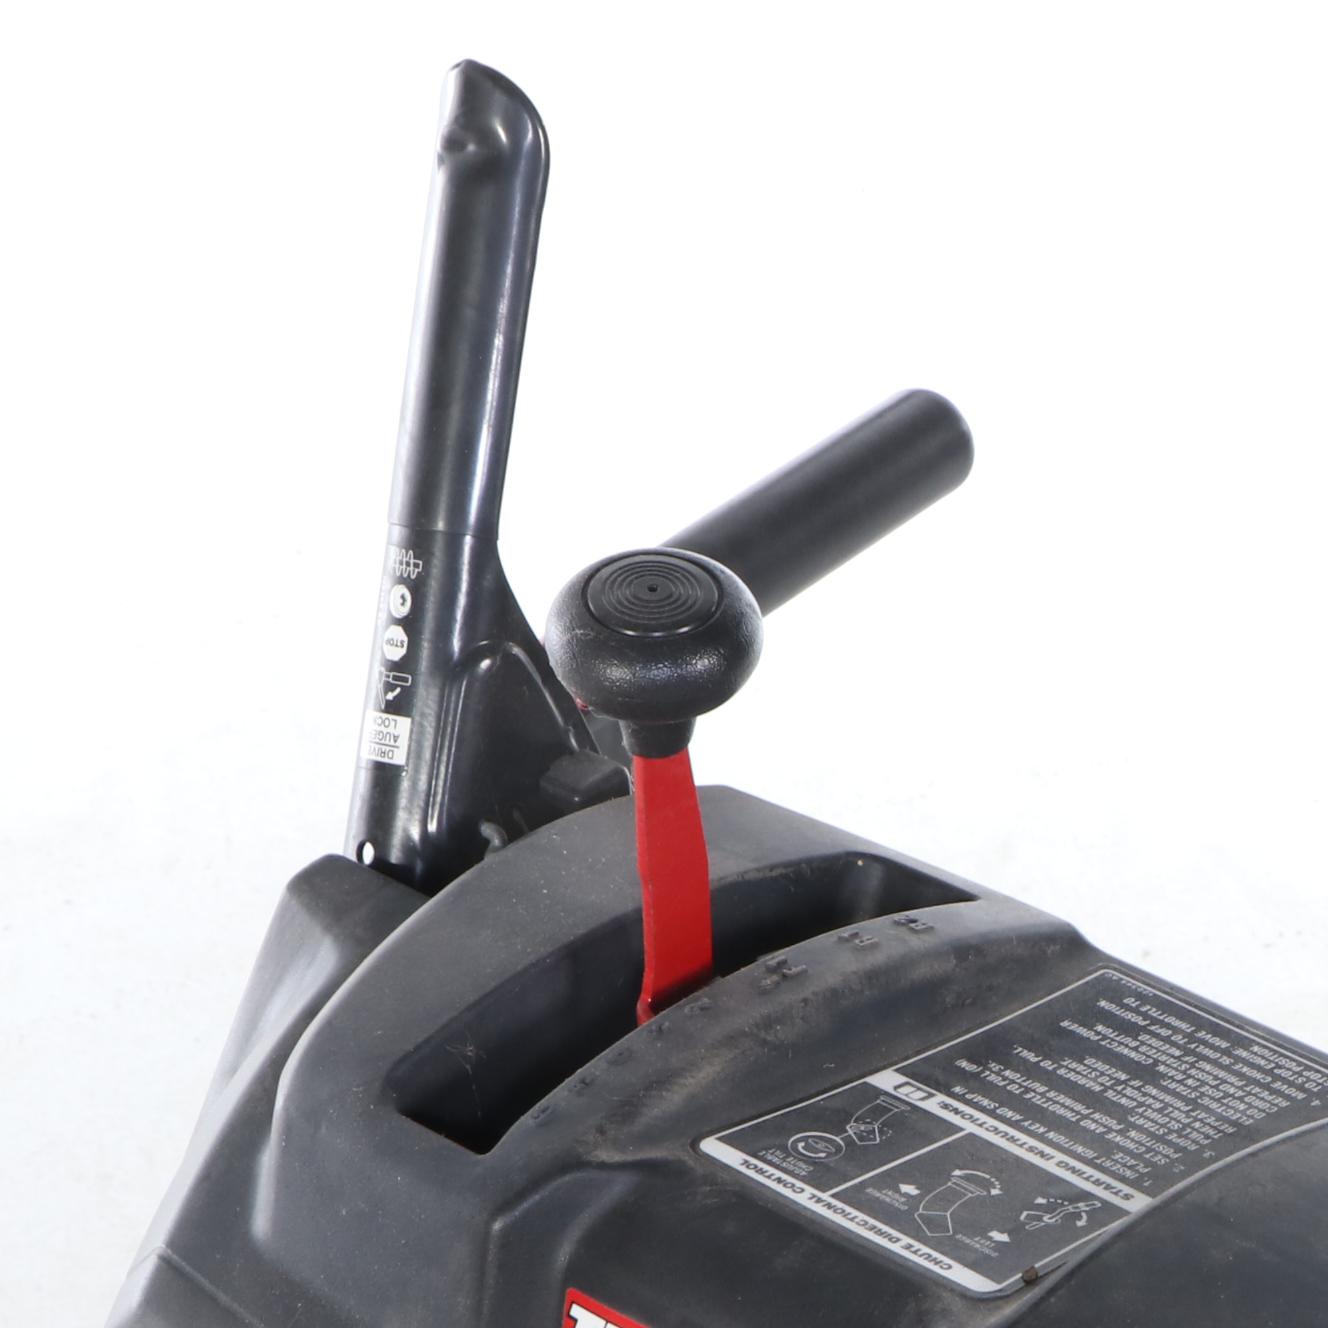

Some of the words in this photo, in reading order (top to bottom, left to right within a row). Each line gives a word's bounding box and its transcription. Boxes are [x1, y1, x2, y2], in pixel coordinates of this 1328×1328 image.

[385, 638, 405, 649] STOP
[369, 730, 400, 744] AUGE
[1120, 996, 1143, 1007] TO
[1091, 997, 1152, 1026] POSITION.
[1137, 1003, 1197, 1032] THROTTLE
[1057, 1018, 1104, 1041] POWER
[1145, 1022, 1174, 1036] OFF
[1168, 1033, 1190, 1043] TO
[1192, 1029, 1232, 1048] MOVE
[1097, 1037, 1155, 1065] CONNECT
[1132, 1031, 1185, 1056] NEEDED.
[1185, 1041, 1236, 1065] SLOWLY
[951, 1057, 986, 1073] (ON)
[1037, 1059, 1060, 1069] TO
[1135, 1044, 1191, 1071] STARTER
[1179, 1053, 1198, 1062] IF
[976, 1069, 1010, 1086] FULL
[1077, 1055, 1131, 1081] NEEDED.
[1184, 1067, 1222, 1085] PUSH
[1192, 1060, 1248, 1086] PRIMING
[1229, 1061, 1274, 1083] CHOKE
[1270, 1066, 1308, 1084] STOP
[999, 1068, 1049, 1092] BUTTON
[1003, 1083, 1026, 1093] TO
[1054, 1067, 1106, 1091] HARDER
[1095, 1075, 1118, 1086] TO
[1125, 1078, 1145, 1087] IF
[1181, 1077, 1202, 1087] IN
[1301, 1080, 1325, 1092] TO
[949, 1085, 969, 1094] IN
[1099, 1088, 1139, 1107] UNTIL
[1112, 1083, 1166, 1109] RAPIDLY
[1138, 1084, 1194, 1111] PRIMING
[1195, 1084, 1226, 1098] USE
[1216, 1082, 1247, 1097] AND
[1241, 1083, 1292, 1107] REPEAT
[1267, 1080, 1308, 1100] MOVE
[962, 1091, 1001, 1109] SNAP
[1020, 1090, 1083, 1121] THROTTLE
[1043, 1089, 1095, 1114] PRIMER
[1219, 1095, 1250, 1110] NOT
[1240, 1094, 1280, 1113] CORD
[992, 1106, 1024, 1121] AND
[1133, 1105, 1185, 1130] SLOWLY
[1159, 1106, 1195, 1123] PULL
[1194, 1095, 1256, 1125] ELECTRIC
[1244, 1107, 1268, 1119] DO
[1019, 1119, 1049, 1133] KEY
[1076, 1118, 1109, 1133] AND
[1087, 1111, 1126, 1130] PUSH
[1188, 1108, 1239, 1133] REPEAT
[1188, 1120, 1226, 1138] THEN
[932, 1100, 1057, 1161] INSTRUCTIONS:
[1177, 1127, 1214, 1144] PULL
[1042, 1130, 1100, 1158] IGNITION
[1102, 1131, 1148, 1153] CHOKE
[1119, 1127, 1184, 1159] POSITION.
[1163, 1132, 1202, 1150] ROPE
[1092, 1155, 1142, 1179] INSERT
[1104, 1149, 1154, 1173] PLACE.
[1141, 1150, 1172, 1165] SET
[733, 1158, 807, 1194] CONTROL
[1052, 1159, 1137, 1201] STARTING
[800, 1192, 904, 1244] DIRECTIONAL
[897, 1242, 956, 1271] CHUTE
